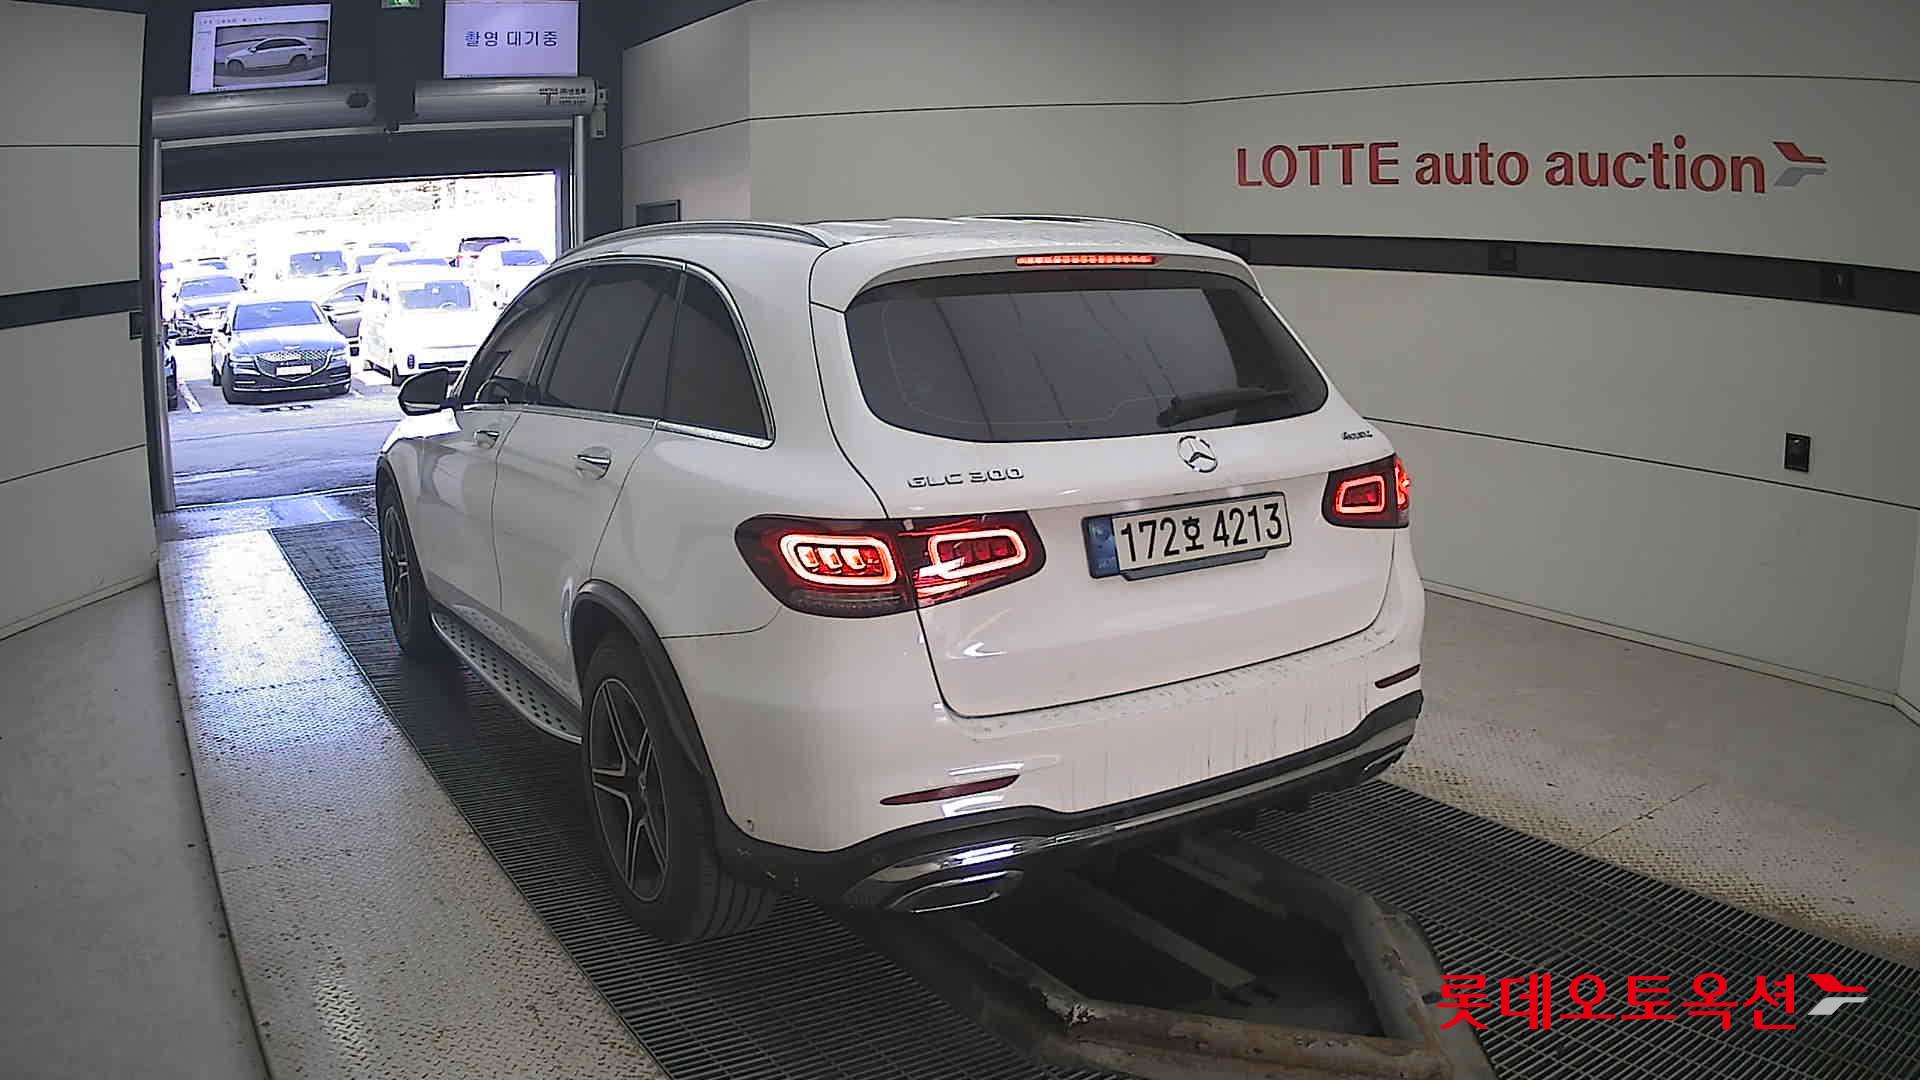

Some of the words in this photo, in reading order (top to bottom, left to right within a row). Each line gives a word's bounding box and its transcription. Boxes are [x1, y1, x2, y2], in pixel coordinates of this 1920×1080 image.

[464, 31, 498, 47] 촬영
[1236, 142, 1400, 188] LOTTE
[1415, 143, 1530, 187] auto
[1545, 135, 1767, 193] auction
[907, 474, 964, 488] GLC
[969, 468, 1025, 483] 300
[1120, 516, 1204, 562] 172호
[1213, 502, 1282, 547] 4213
